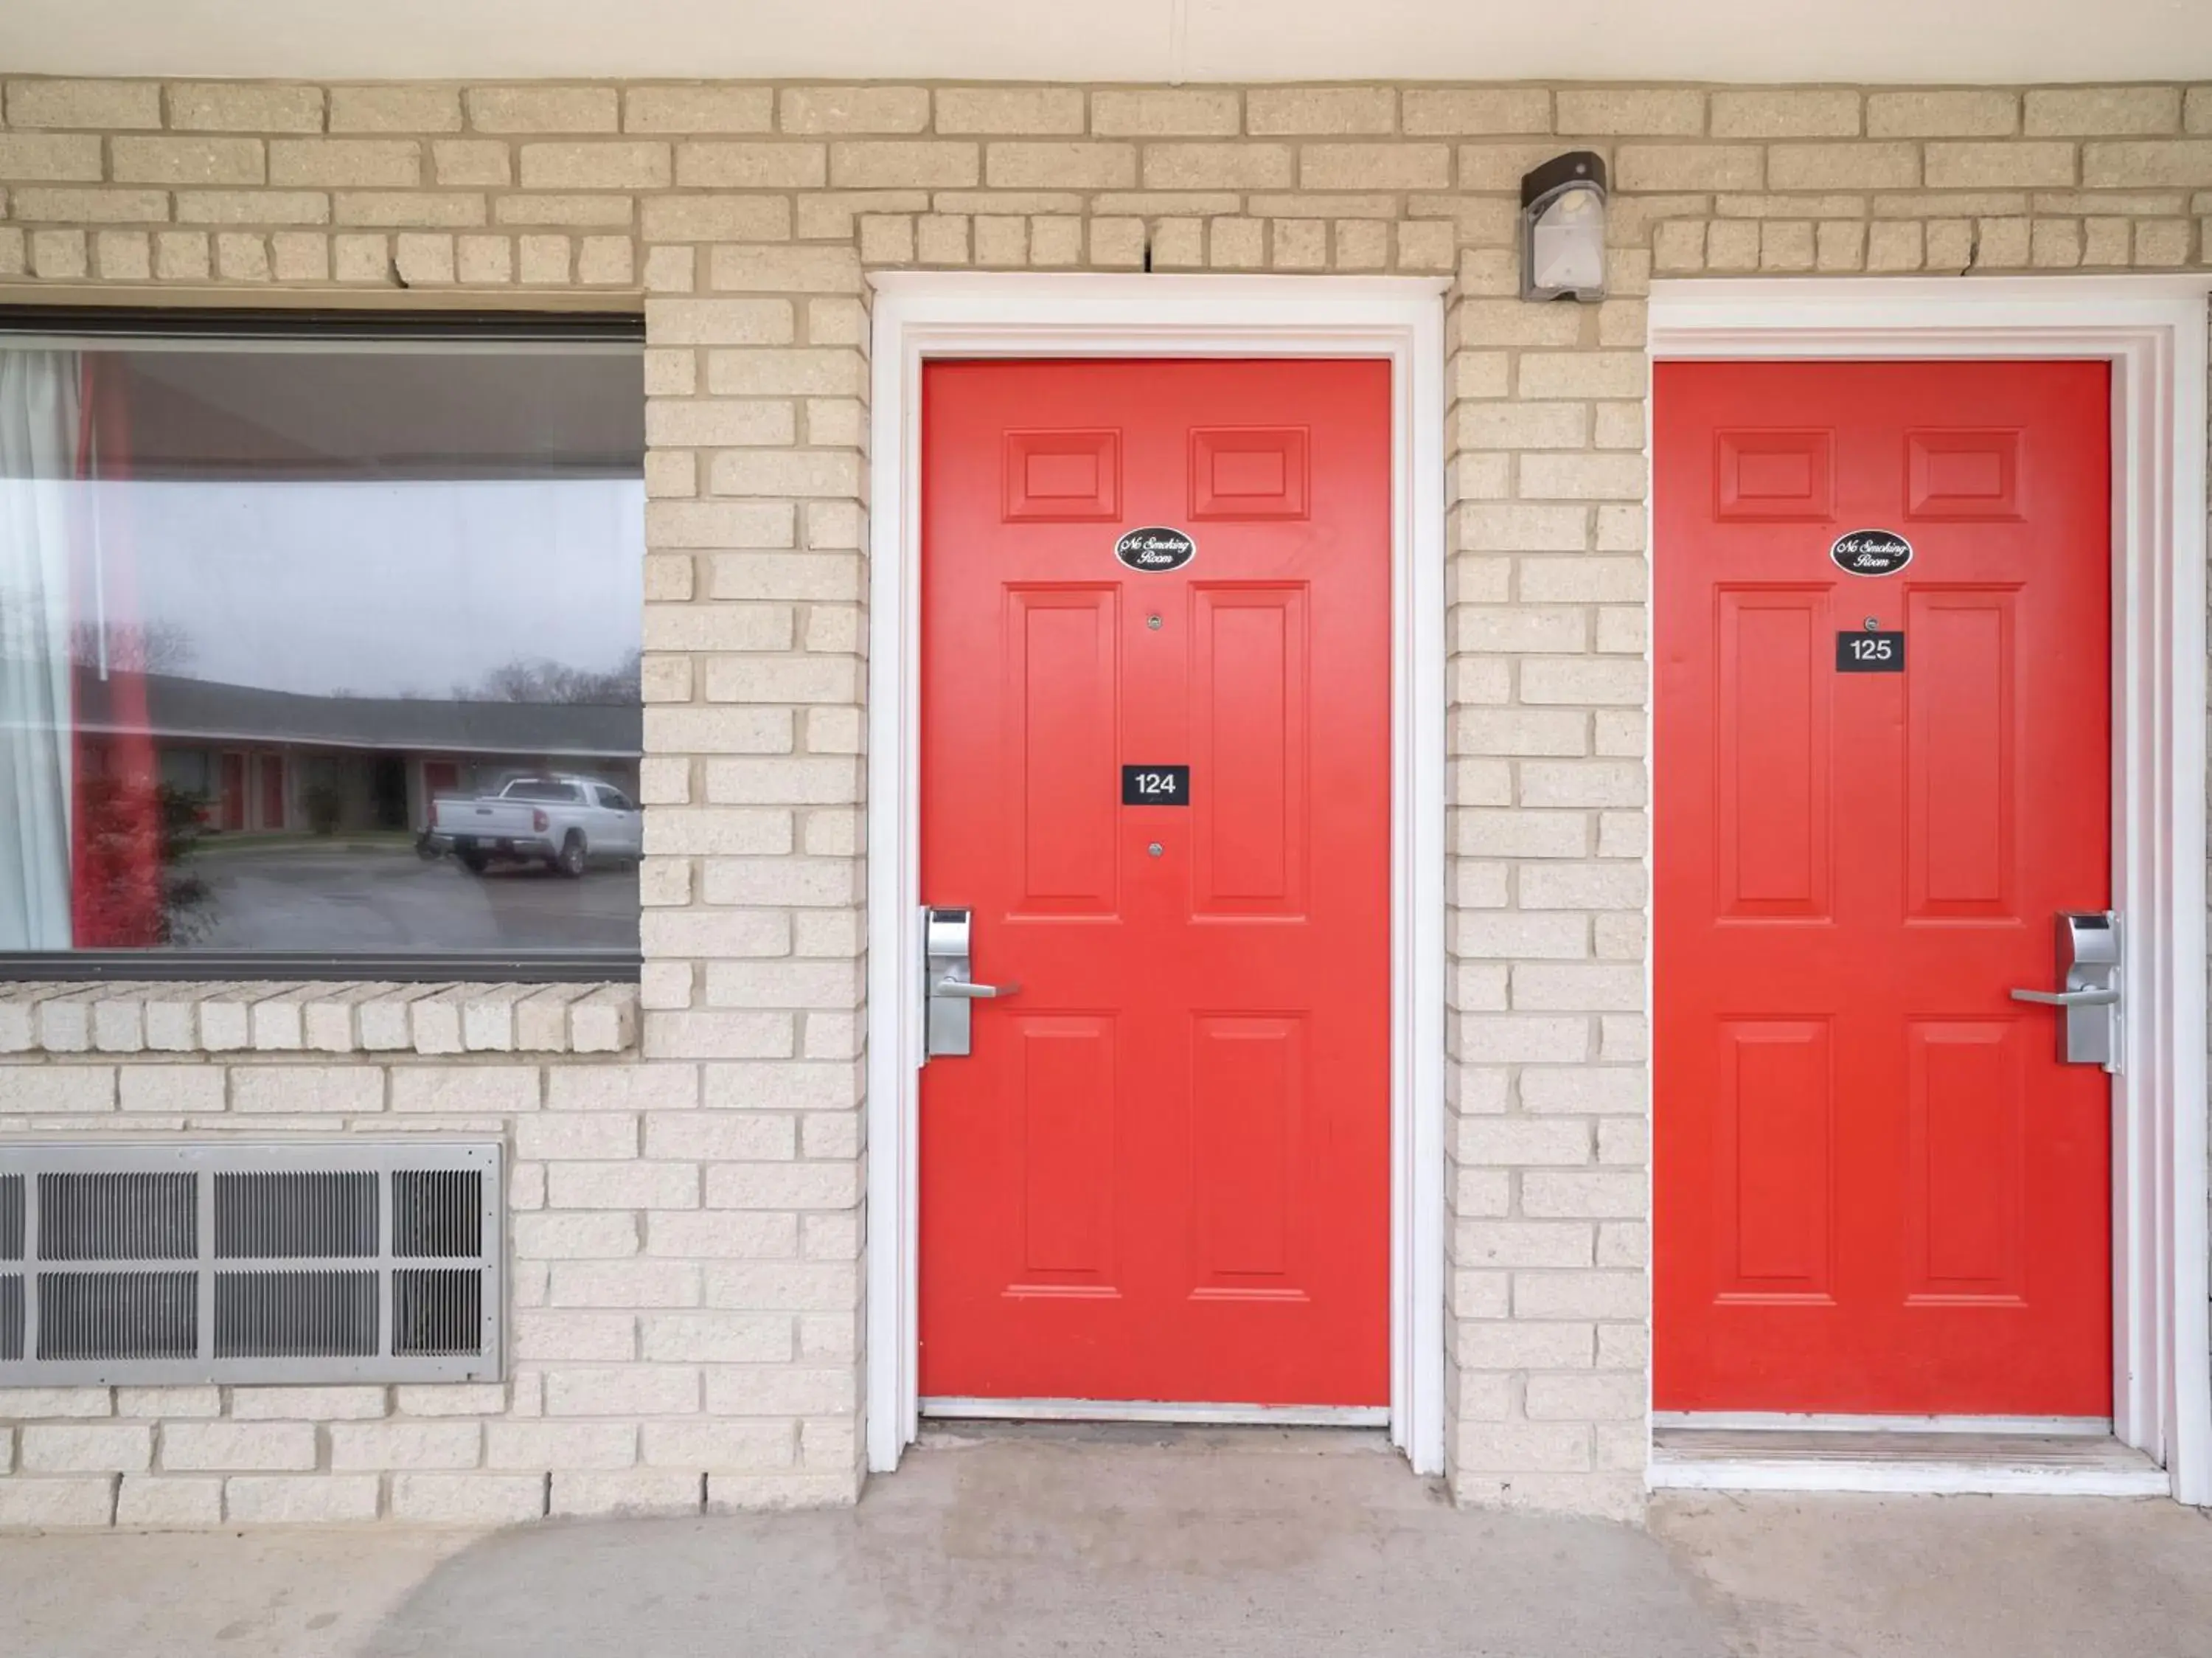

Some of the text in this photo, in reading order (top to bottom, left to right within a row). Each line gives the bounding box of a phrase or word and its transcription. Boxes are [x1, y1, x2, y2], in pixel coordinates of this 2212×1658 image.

[1120, 536, 1189, 554] No Smoking
[1836, 539, 1907, 557] No Smoking
[1136, 549, 1174, 564] Room
[1853, 553, 1891, 567] Room
[1849, 639, 1892, 659] 125
[1135, 774, 1177, 794] 124
